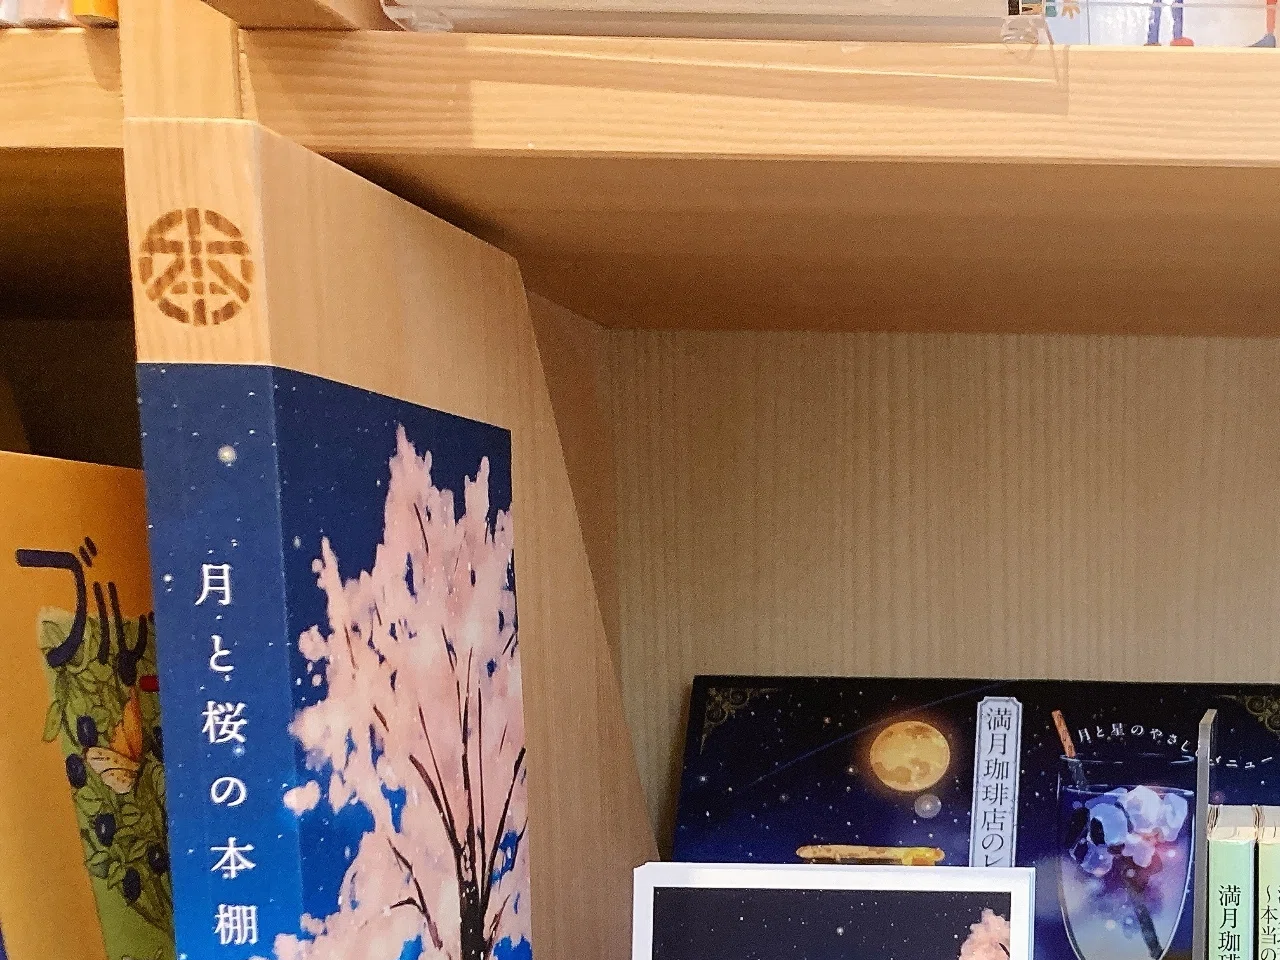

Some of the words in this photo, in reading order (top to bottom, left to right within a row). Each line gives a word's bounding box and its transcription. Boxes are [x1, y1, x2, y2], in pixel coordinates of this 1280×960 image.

[15, 537, 154, 686] ブル
[194, 563, 258, 945] 月と桜の本棚
